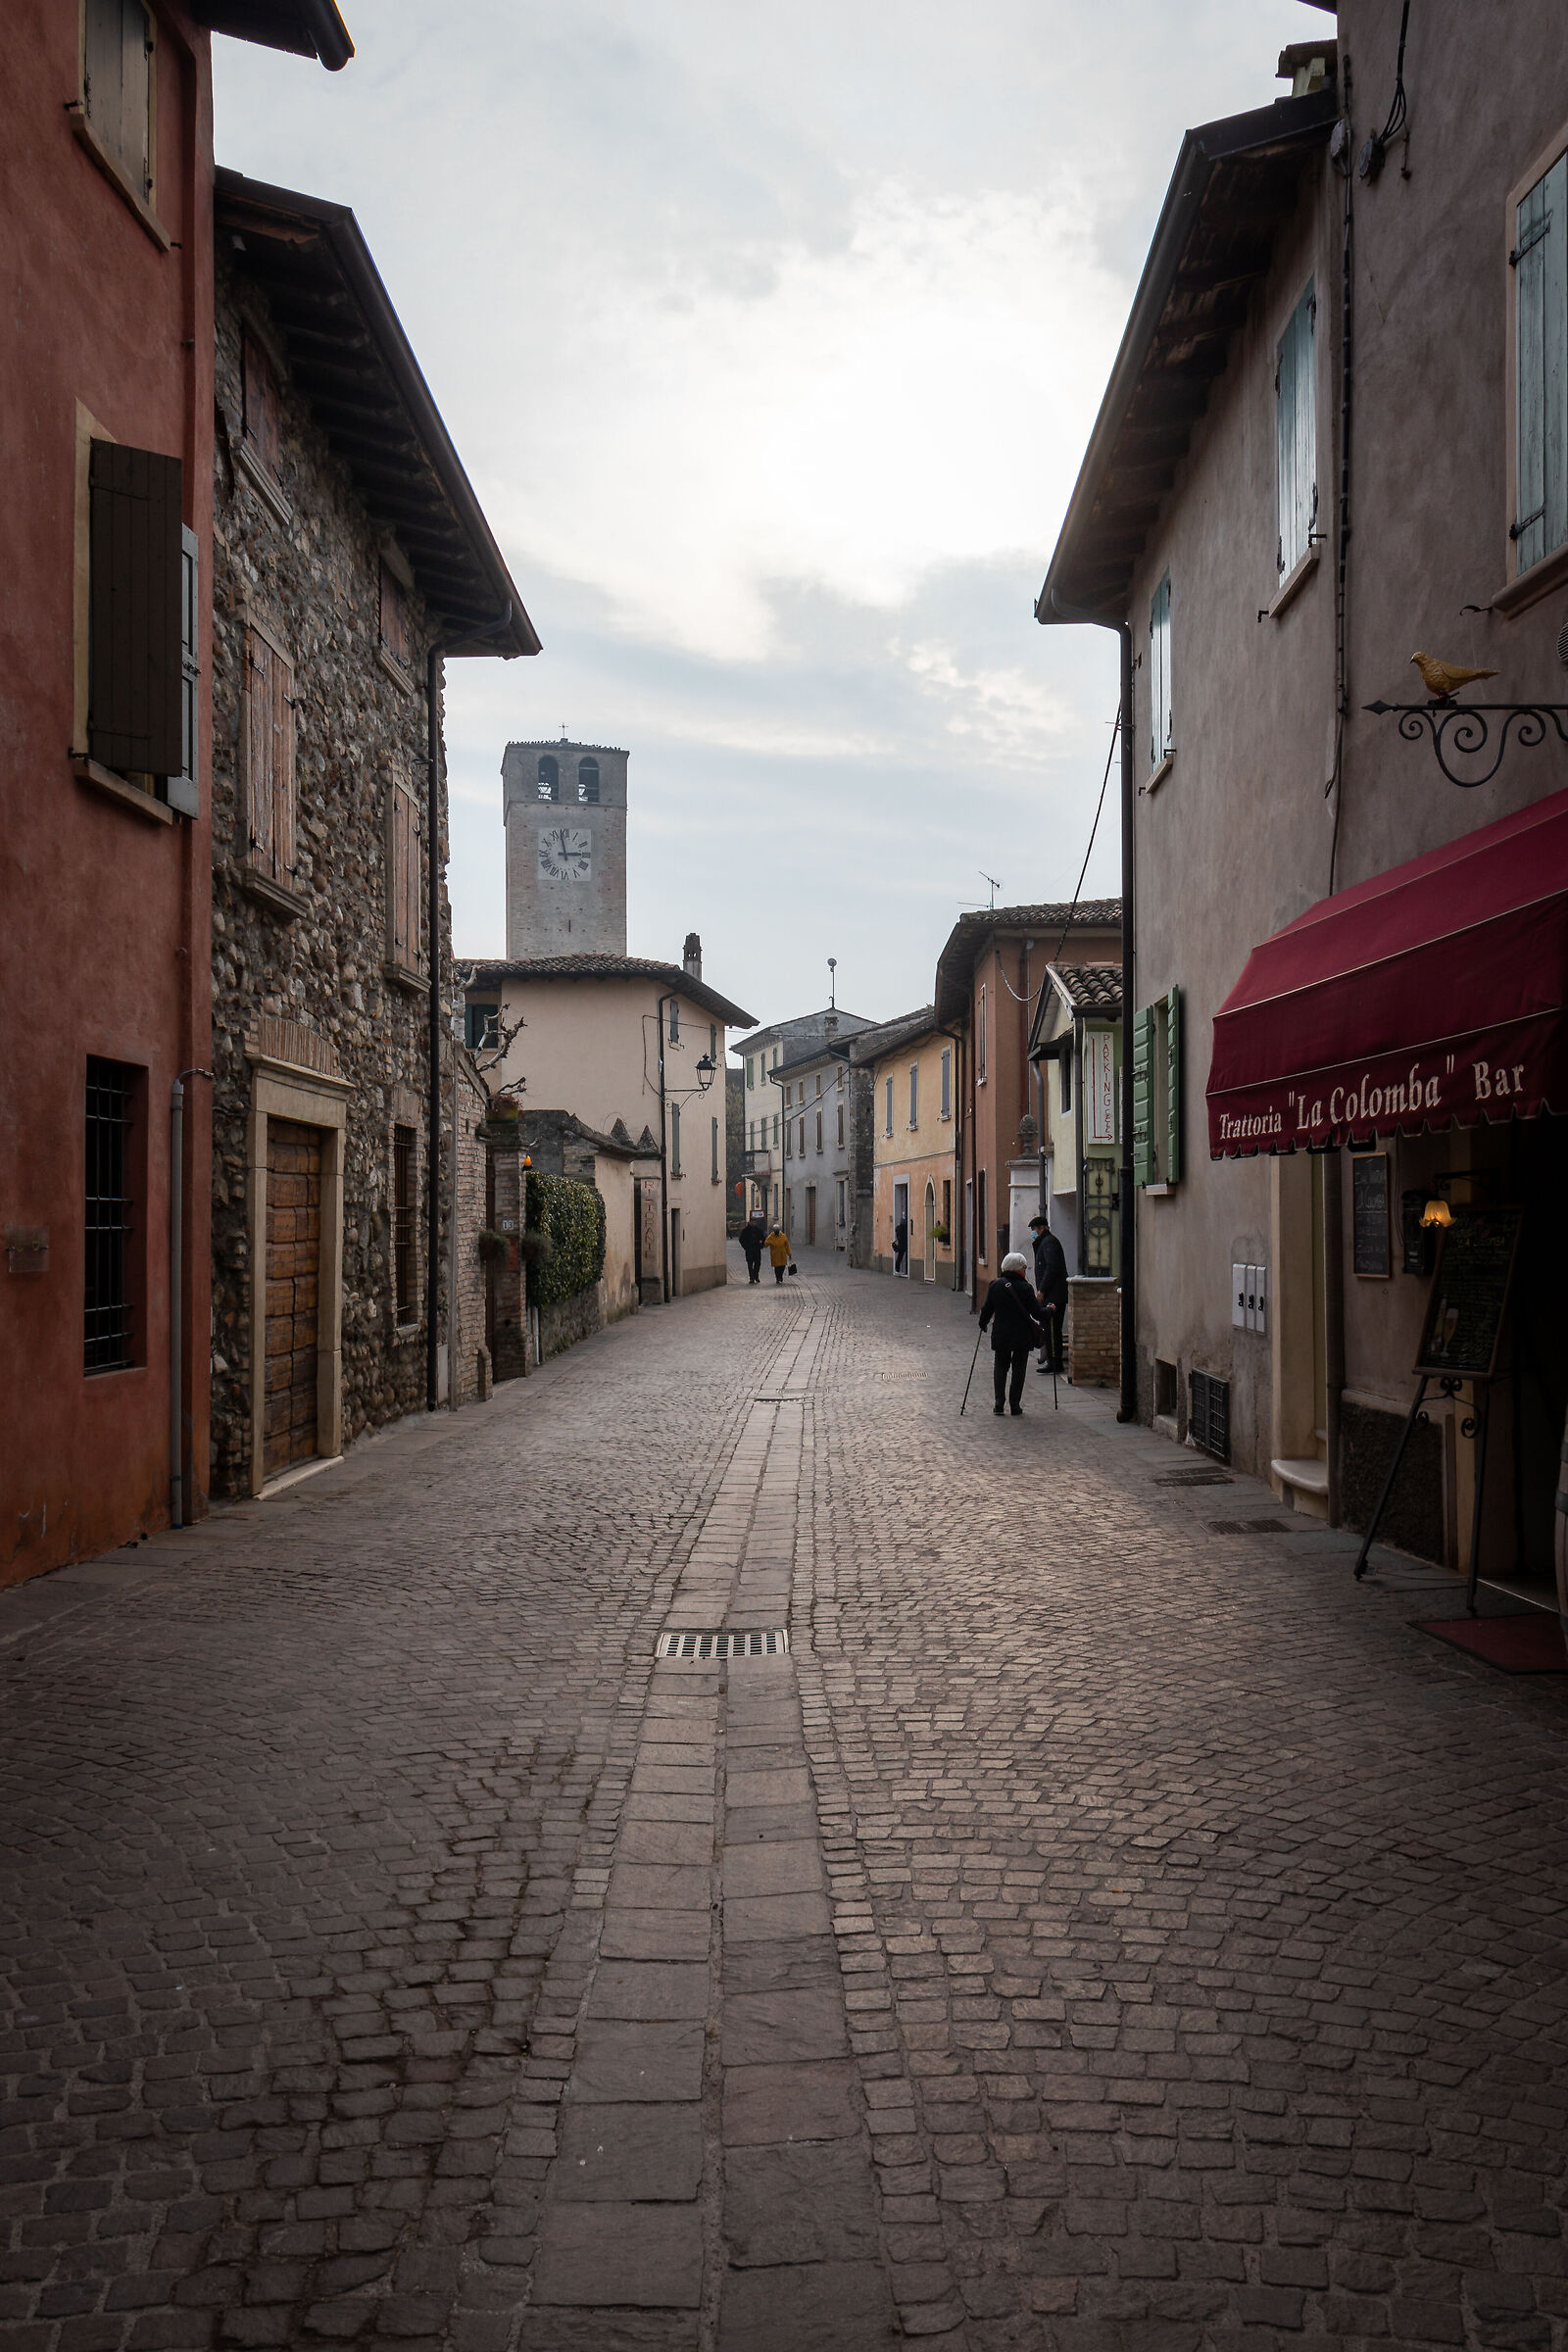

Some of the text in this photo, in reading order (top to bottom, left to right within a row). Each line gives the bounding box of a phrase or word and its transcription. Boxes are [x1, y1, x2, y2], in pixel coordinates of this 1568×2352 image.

[1102, 1035, 1111, 1106] PARKING
[1219, 1105, 1283, 1140] Trattoria
[1472, 1060, 1525, 1101] Bar
